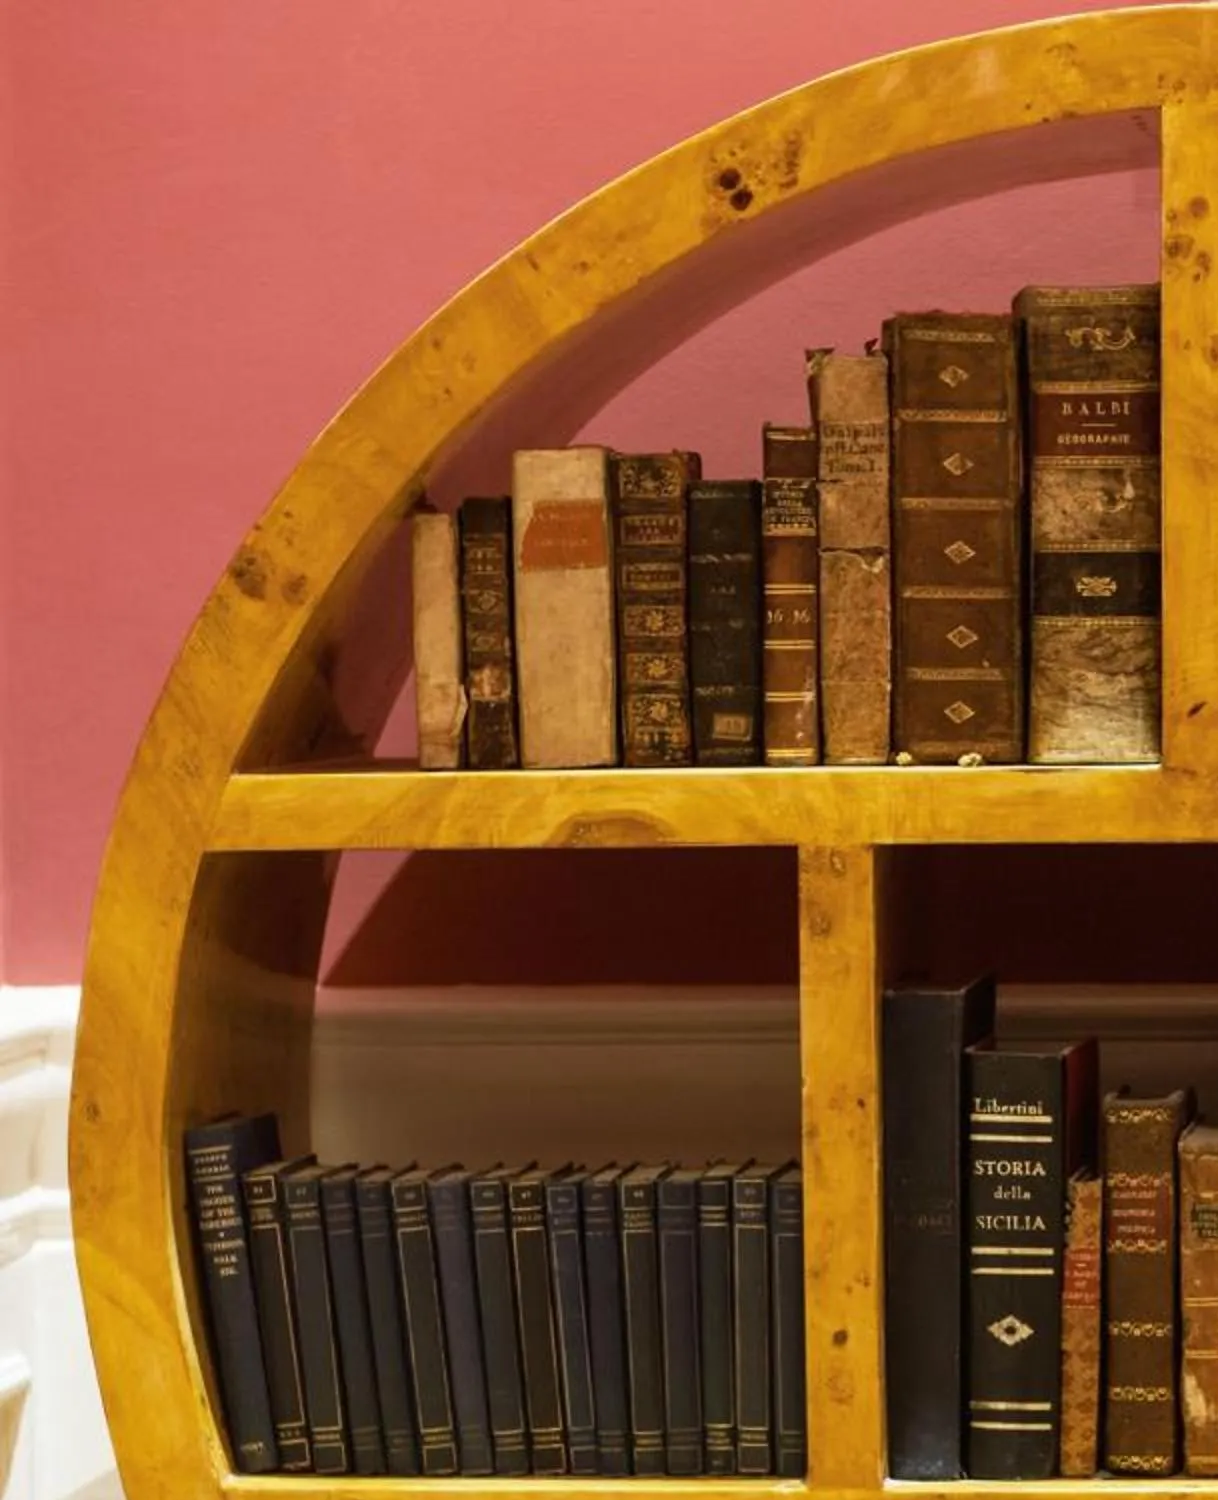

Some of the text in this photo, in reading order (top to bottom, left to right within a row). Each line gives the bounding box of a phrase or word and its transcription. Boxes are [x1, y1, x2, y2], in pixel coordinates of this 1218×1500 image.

[1061, 400, 1131, 416] BALBI
[973, 1097, 1043, 1114] Libertini
[973, 1159, 1047, 1177] STORIA
[993, 1185, 1031, 1200] della
[975, 1215, 1046, 1231] SICILIA
